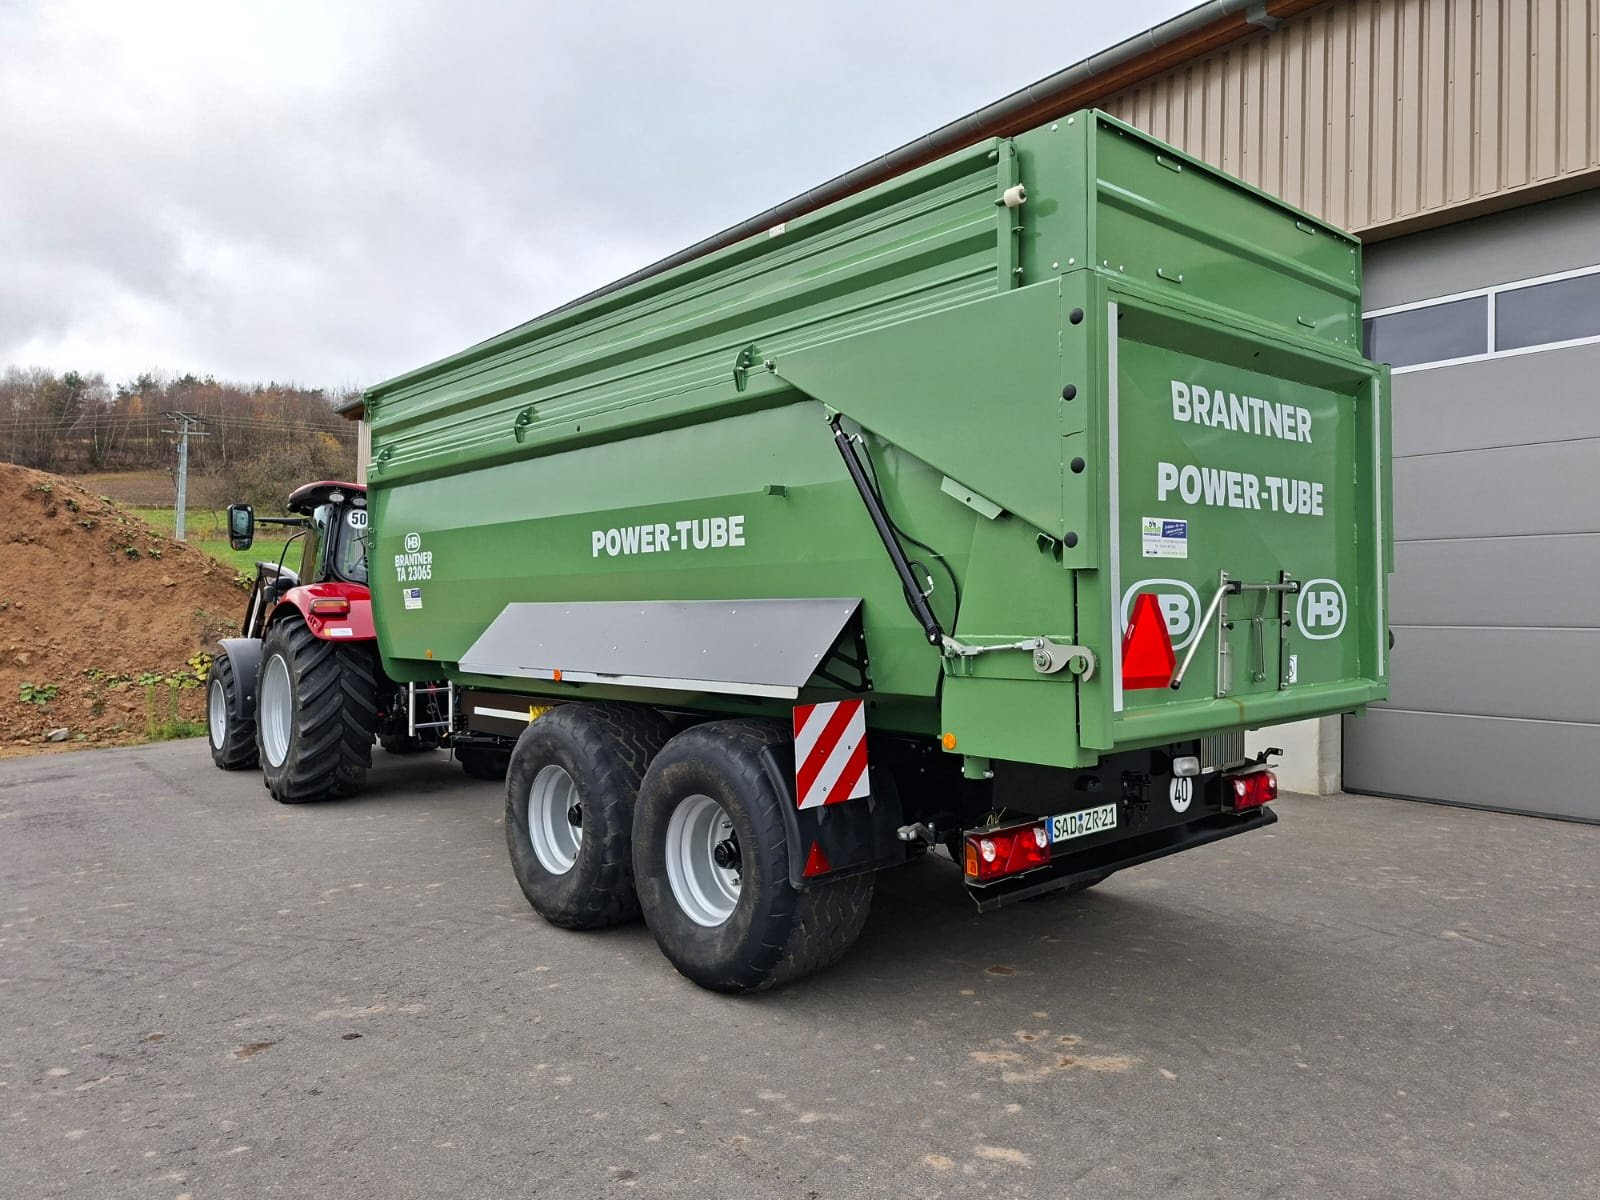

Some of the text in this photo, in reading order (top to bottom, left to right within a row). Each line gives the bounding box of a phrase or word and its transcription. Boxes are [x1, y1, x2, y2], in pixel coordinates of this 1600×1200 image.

[1170, 380, 1313, 444] BRANTNER
[1157, 461, 1324, 517] POWER-TUBE
[351, 512, 367, 525] 50
[591, 515, 746, 558] POWER-TUBE
[394, 551, 433, 568] BRANTNER
[396, 564, 432, 582] TA 23065
[1306, 591, 1341, 627] HB
[1174, 777, 1188, 804] 40
[1053, 815, 1077, 839] SAD
